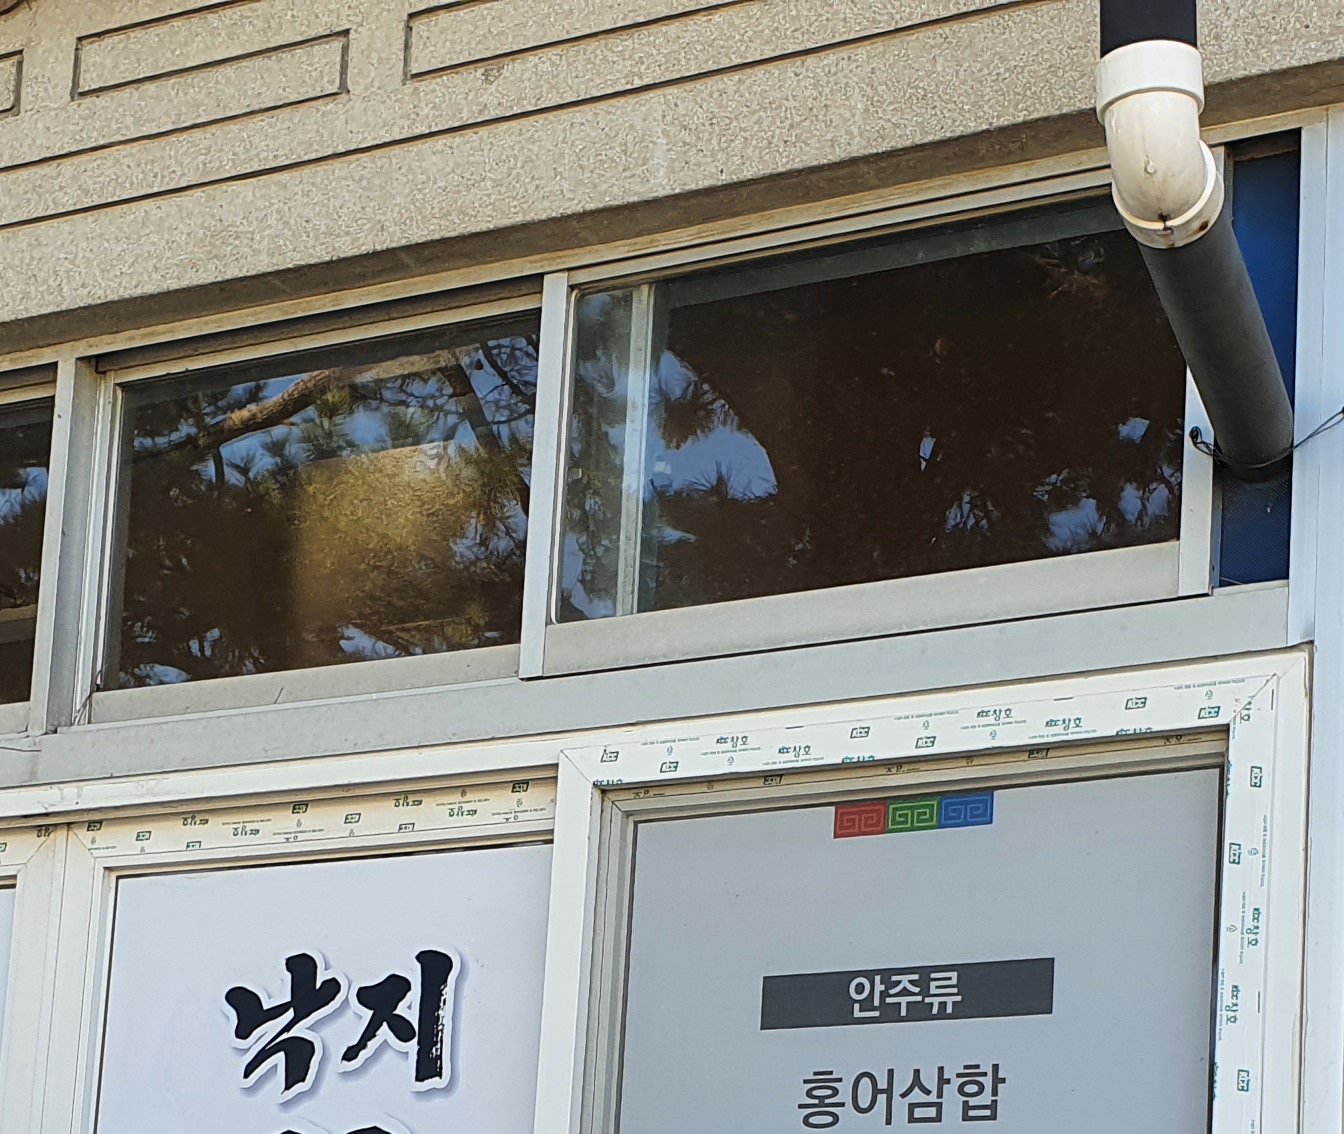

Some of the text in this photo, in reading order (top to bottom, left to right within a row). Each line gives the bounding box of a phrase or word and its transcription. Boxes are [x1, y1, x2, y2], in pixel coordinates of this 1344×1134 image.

[225, 949, 454, 1093] 낙지
[849, 971, 963, 1018] 안주류
[797, 1063, 1006, 1129] 홍어삼합
